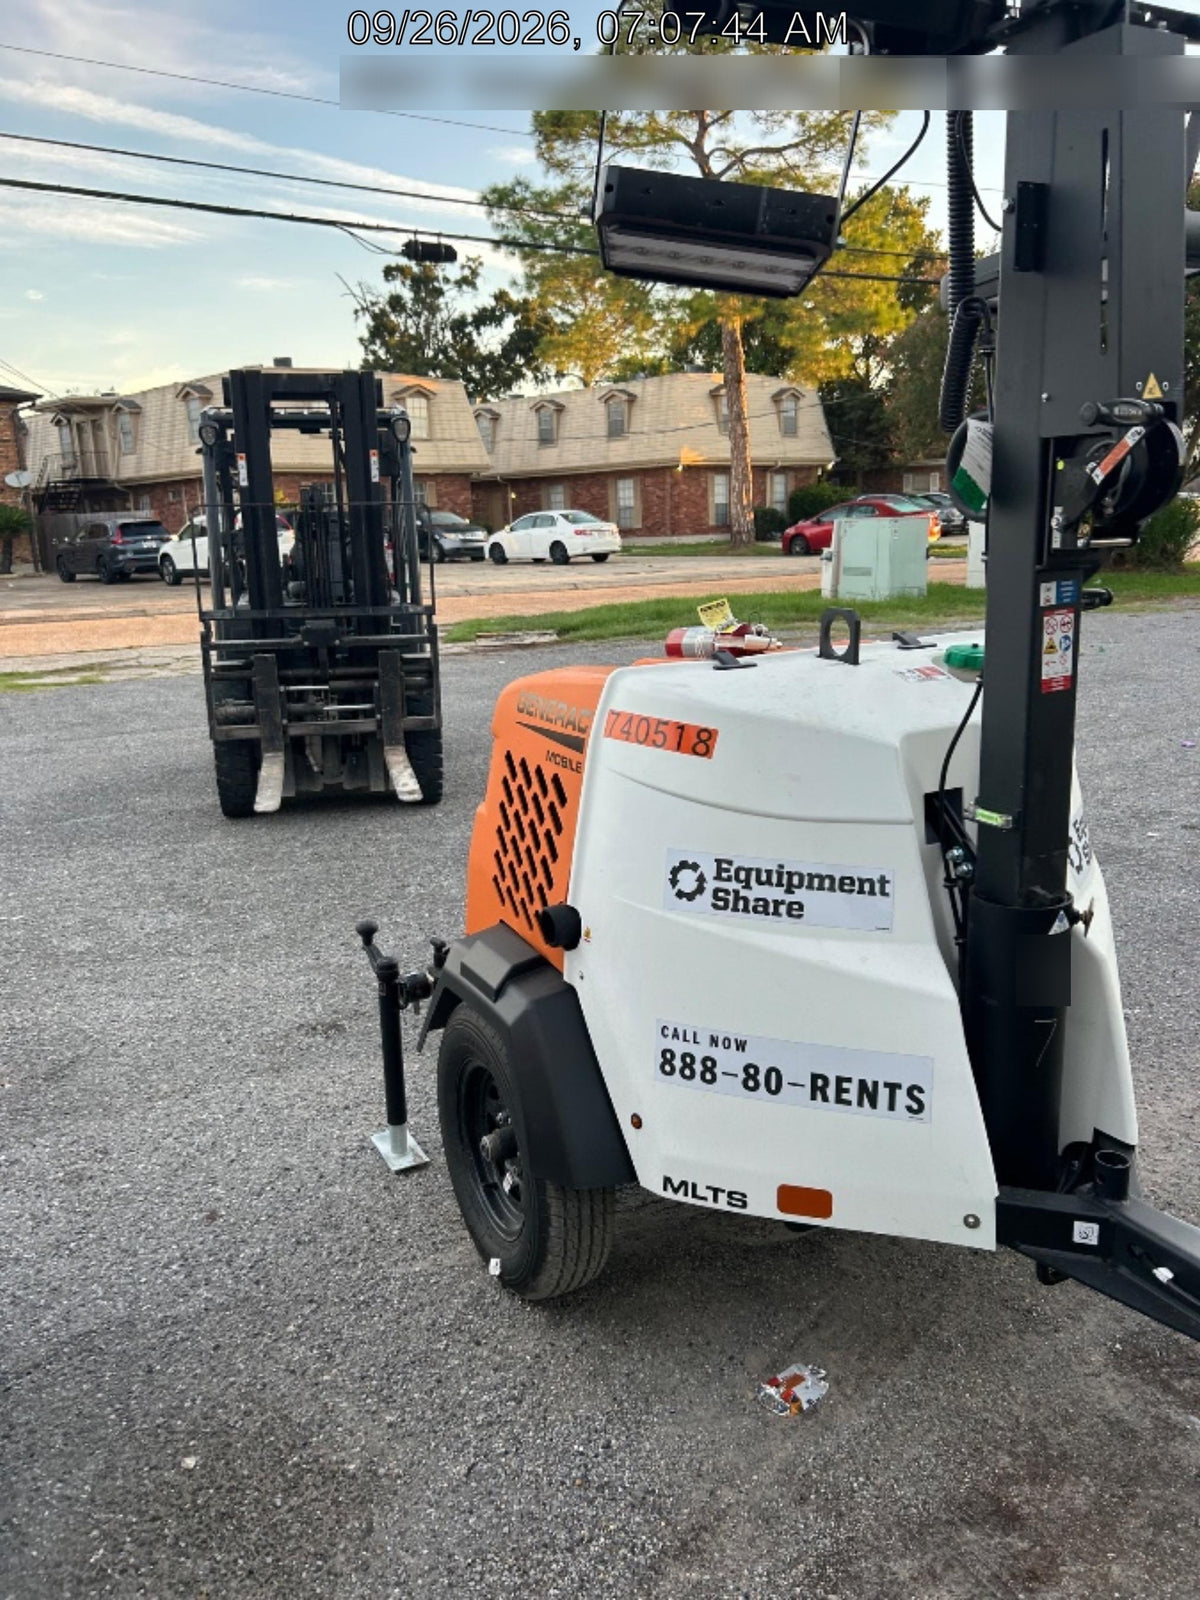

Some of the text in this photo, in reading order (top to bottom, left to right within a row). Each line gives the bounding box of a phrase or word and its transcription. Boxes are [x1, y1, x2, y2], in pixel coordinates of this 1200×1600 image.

[516, 690, 592, 733] GENERAC
[608, 710, 713, 757] 740518
[545, 750, 582, 773] MOBILE
[713, 858, 890, 897] Equipment
[711, 887, 804, 919] Share
[661, 1025, 747, 1052] CALL NOW
[659, 1048, 925, 1116] 888-80-RENTS
[663, 1175, 748, 1209] MLTS
